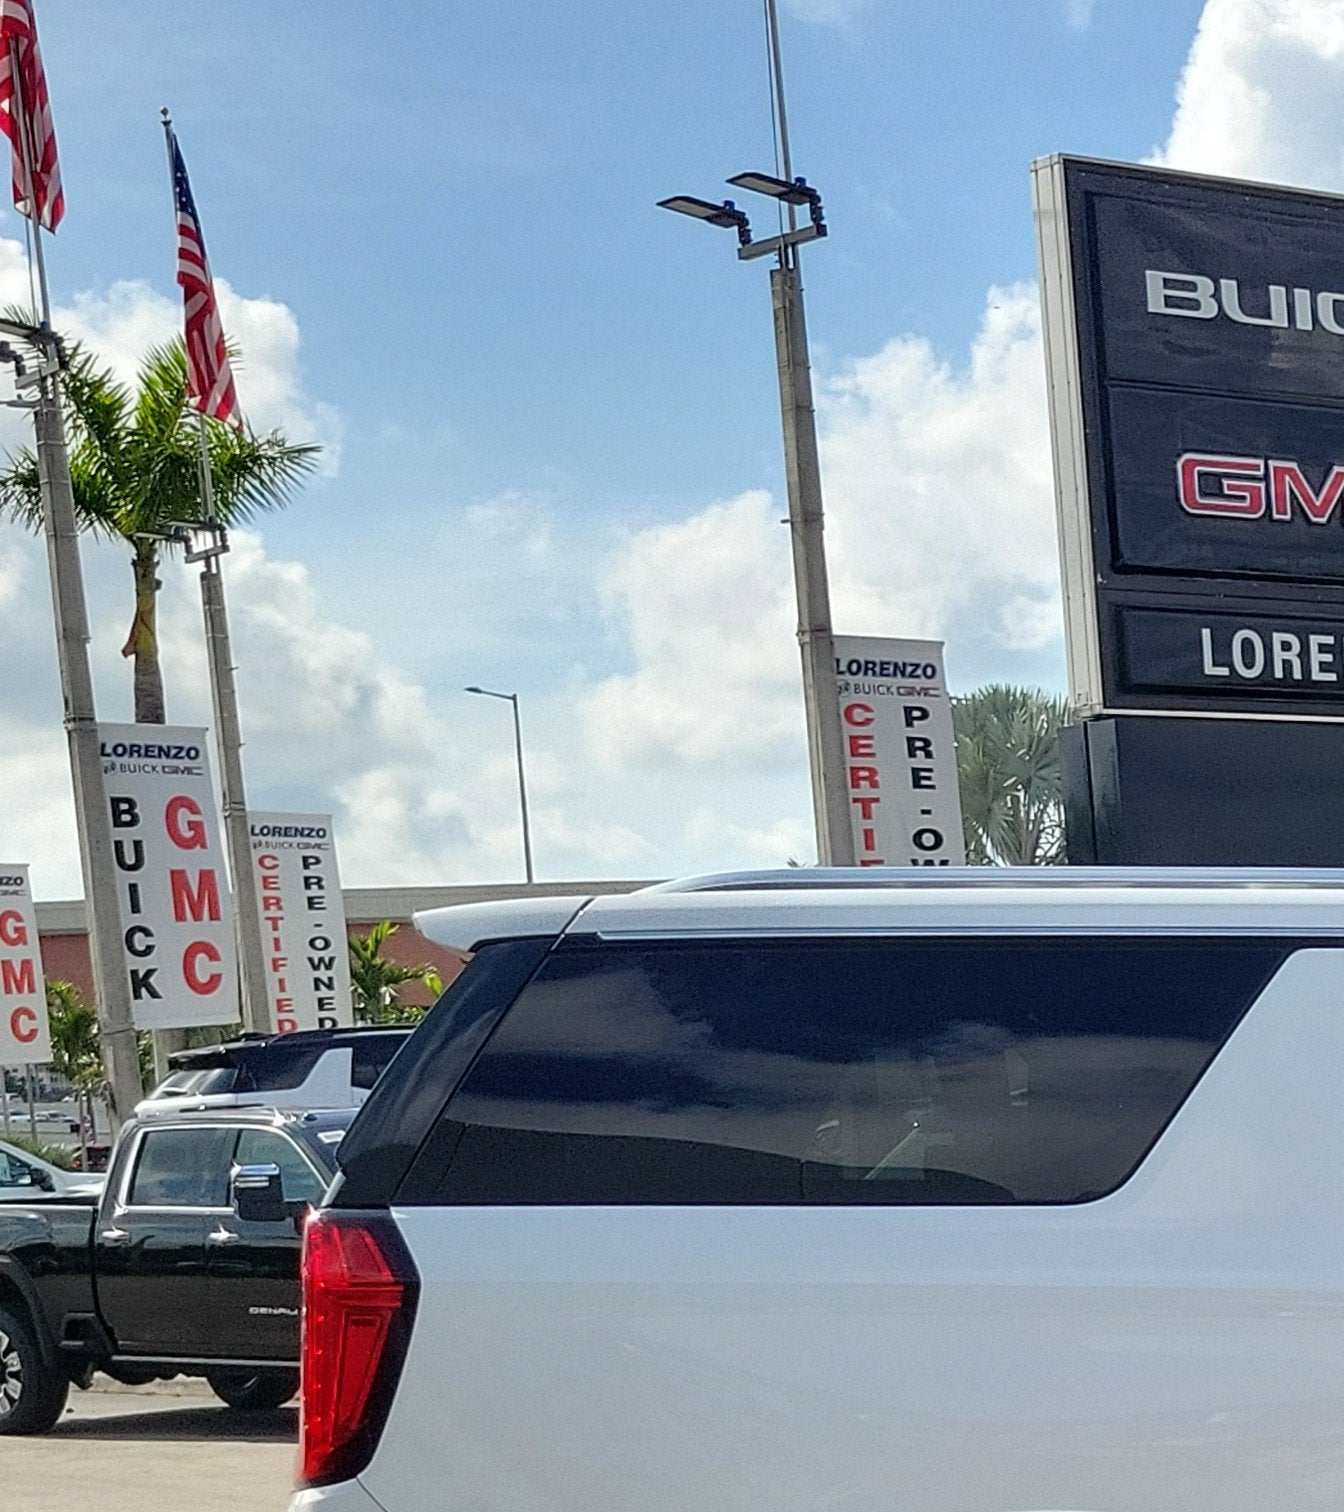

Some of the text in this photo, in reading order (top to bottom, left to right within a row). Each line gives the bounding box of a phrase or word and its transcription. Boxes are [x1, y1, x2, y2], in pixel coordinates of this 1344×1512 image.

[835, 658, 937, 680] LORENZO
[853, 683, 942, 698] BUICK GMC
[100, 742, 200, 760] LORENZO
[120, 763, 204, 776] BUICK GMC
[250, 824, 327, 839] LORENZO
[110, 796, 163, 1000] BUICK
[165, 795, 222, 995] GMC
[0, 909, 39, 1043] GMC
[258, 854, 298, 1034] CERTIFIED
[302, 855, 339, 1030] PRE-OWNED
